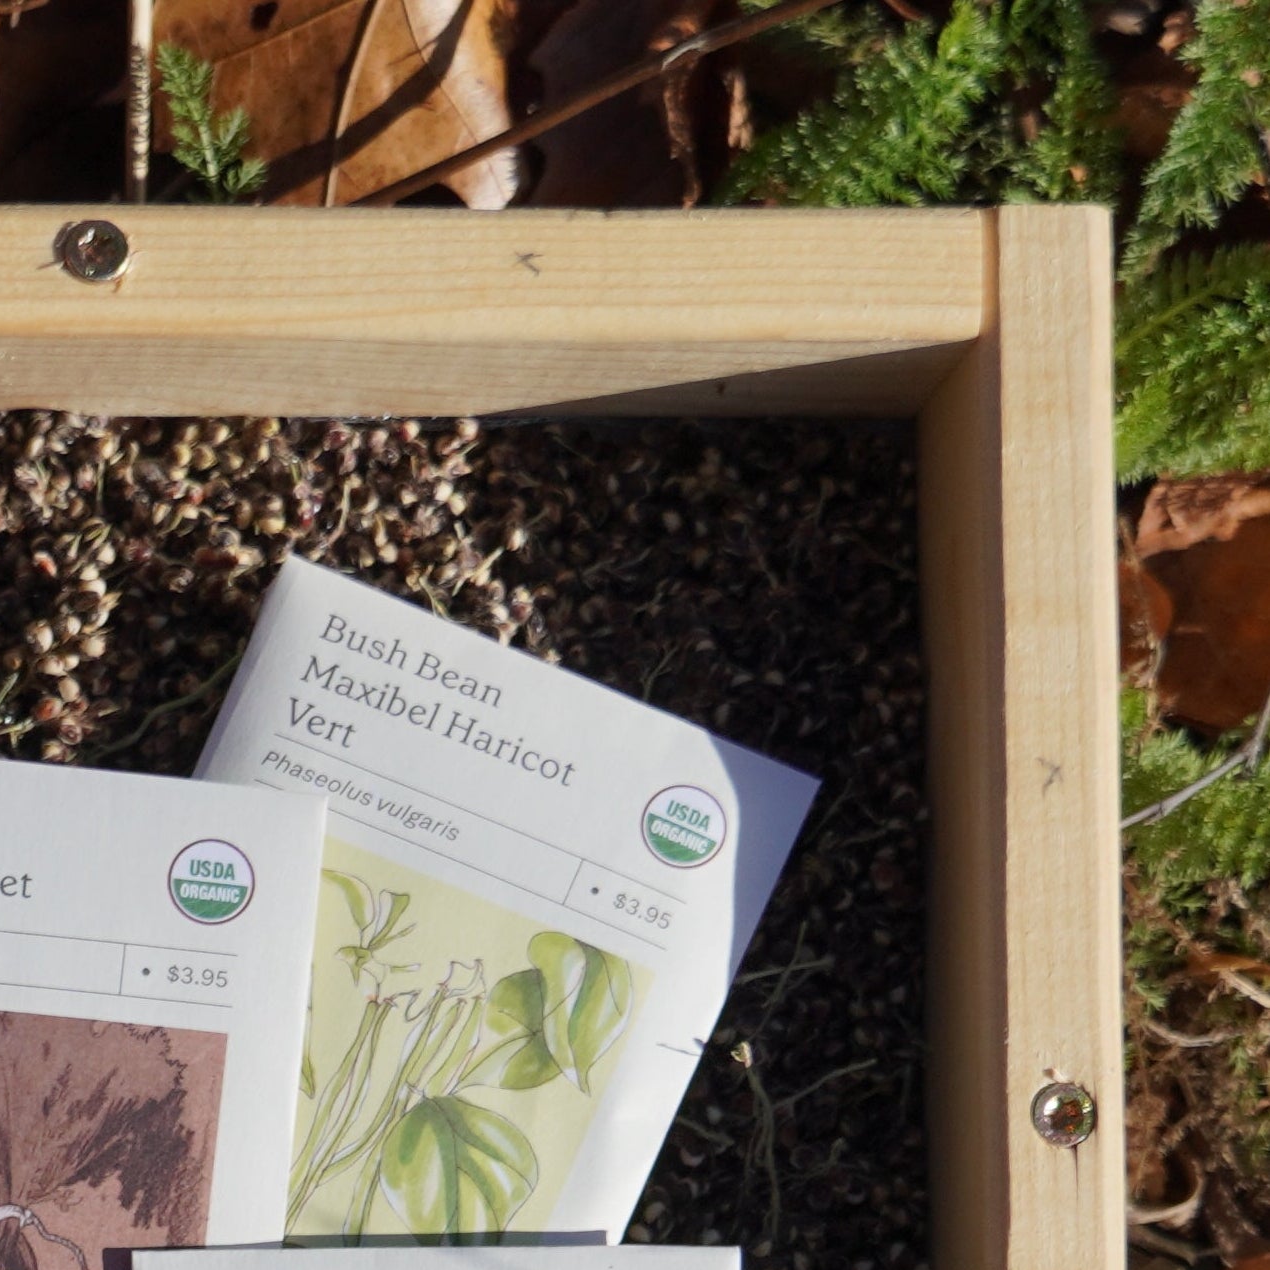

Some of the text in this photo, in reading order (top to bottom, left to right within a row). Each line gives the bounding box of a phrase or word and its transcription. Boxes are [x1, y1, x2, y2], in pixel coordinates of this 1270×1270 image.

[319, 613, 502, 708] Bush Bean
[289, 696, 356, 749] Vert
[299, 655, 576, 787] Maxibel Haricot
[260, 750, 460, 841] Phaseolus vulgaris
[665, 799, 711, 833] USDA
[650, 818, 710, 855] ORGANIC
[190, 859, 236, 882] USDA
[179, 883, 240, 904] ORGANIC
[612, 892, 672, 930] $3.95
[166, 964, 229, 989] $3.95
